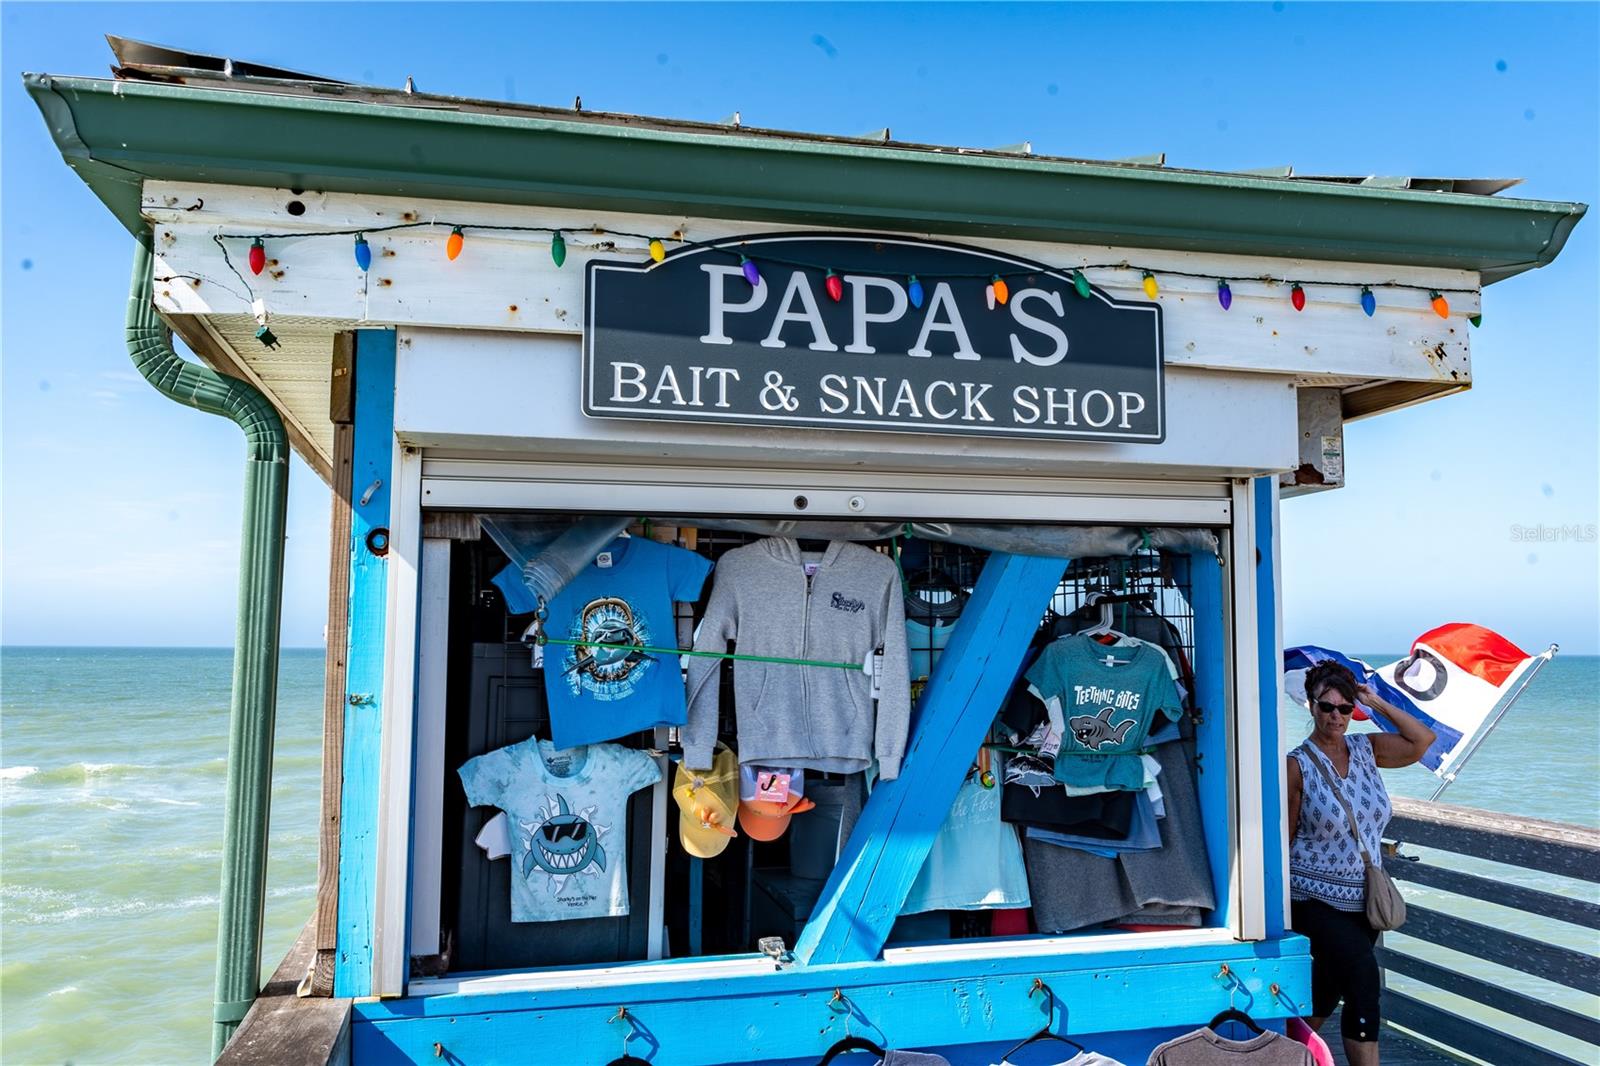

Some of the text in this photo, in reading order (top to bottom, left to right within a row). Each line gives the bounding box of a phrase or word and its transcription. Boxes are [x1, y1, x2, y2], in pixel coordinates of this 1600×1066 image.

[699, 263, 1069, 367] PAPA'S
[609, 361, 1146, 429] BAIT & SNACK SHOP
[1074, 685, 1140, 711] TEETHING BITES
